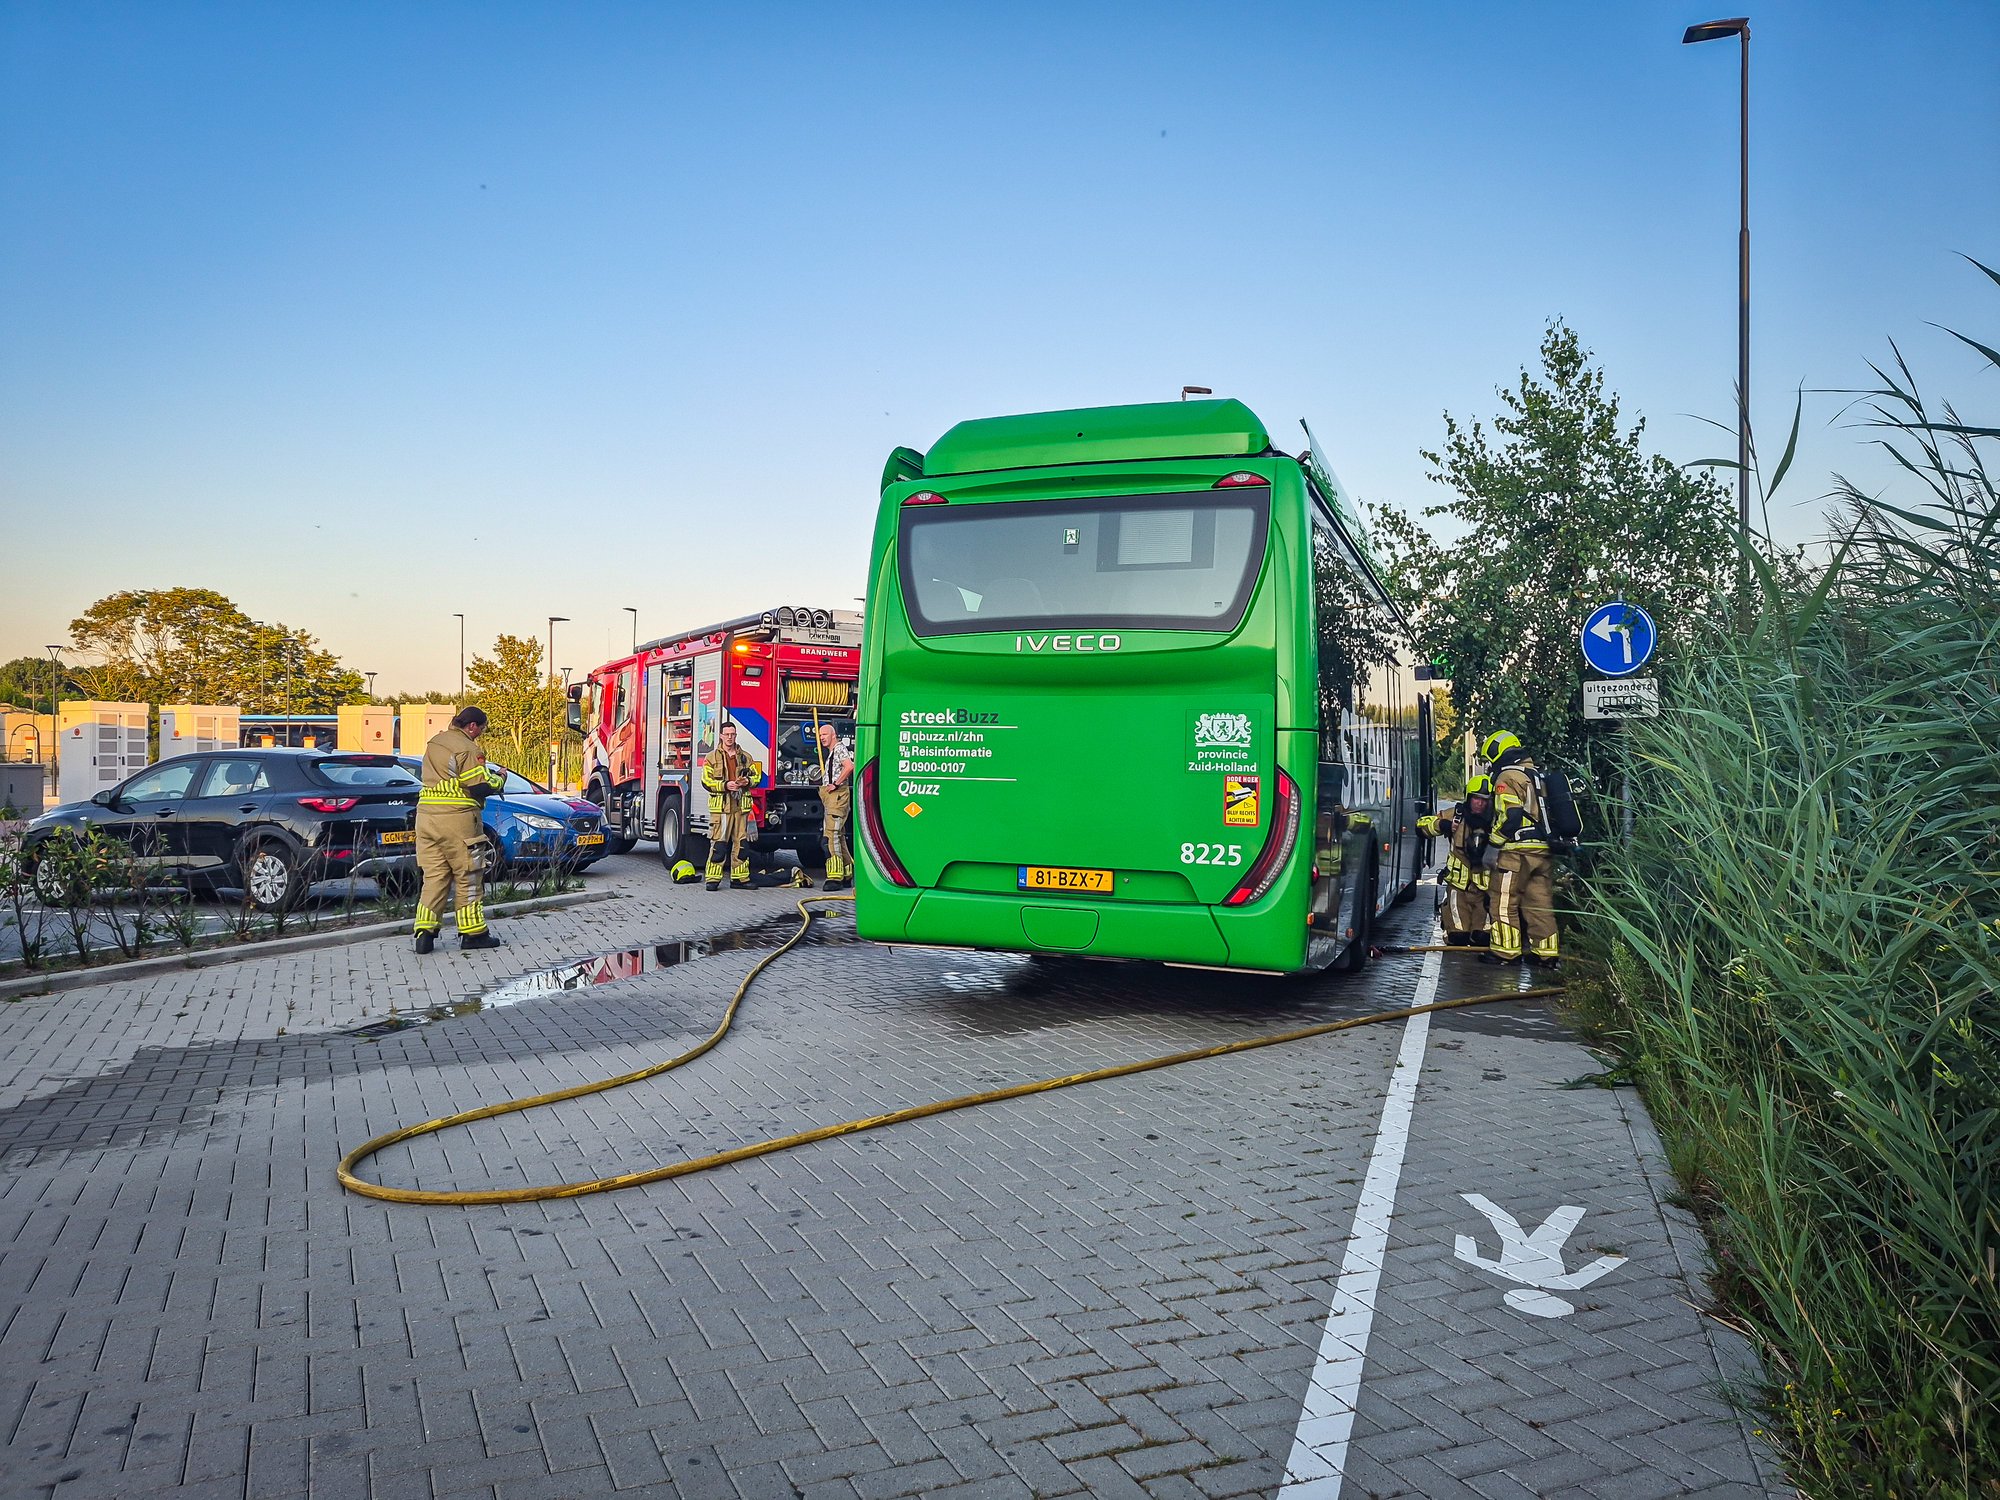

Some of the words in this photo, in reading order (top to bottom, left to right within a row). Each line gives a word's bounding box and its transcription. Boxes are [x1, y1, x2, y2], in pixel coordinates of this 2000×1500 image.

[1015, 634, 1121, 652] IVECO
[800, 648, 848, 658] BRANDWEER
[1587, 683, 1653, 695] uitgezonderd
[900, 708, 999, 724] streekBuzz
[912, 731, 984, 743] qbuzz.nl/zhn
[911, 745, 992, 758] Reisinformatie
[1198, 749, 1248, 760] provincie
[911, 762, 966, 773] 0900-0107
[1188, 762, 1257, 773] Zuid-Holland
[898, 780, 941, 797] Qbuzz
[1180, 842, 1242, 867] 8225
[1035, 870, 1104, 888] 81-BZX-7
